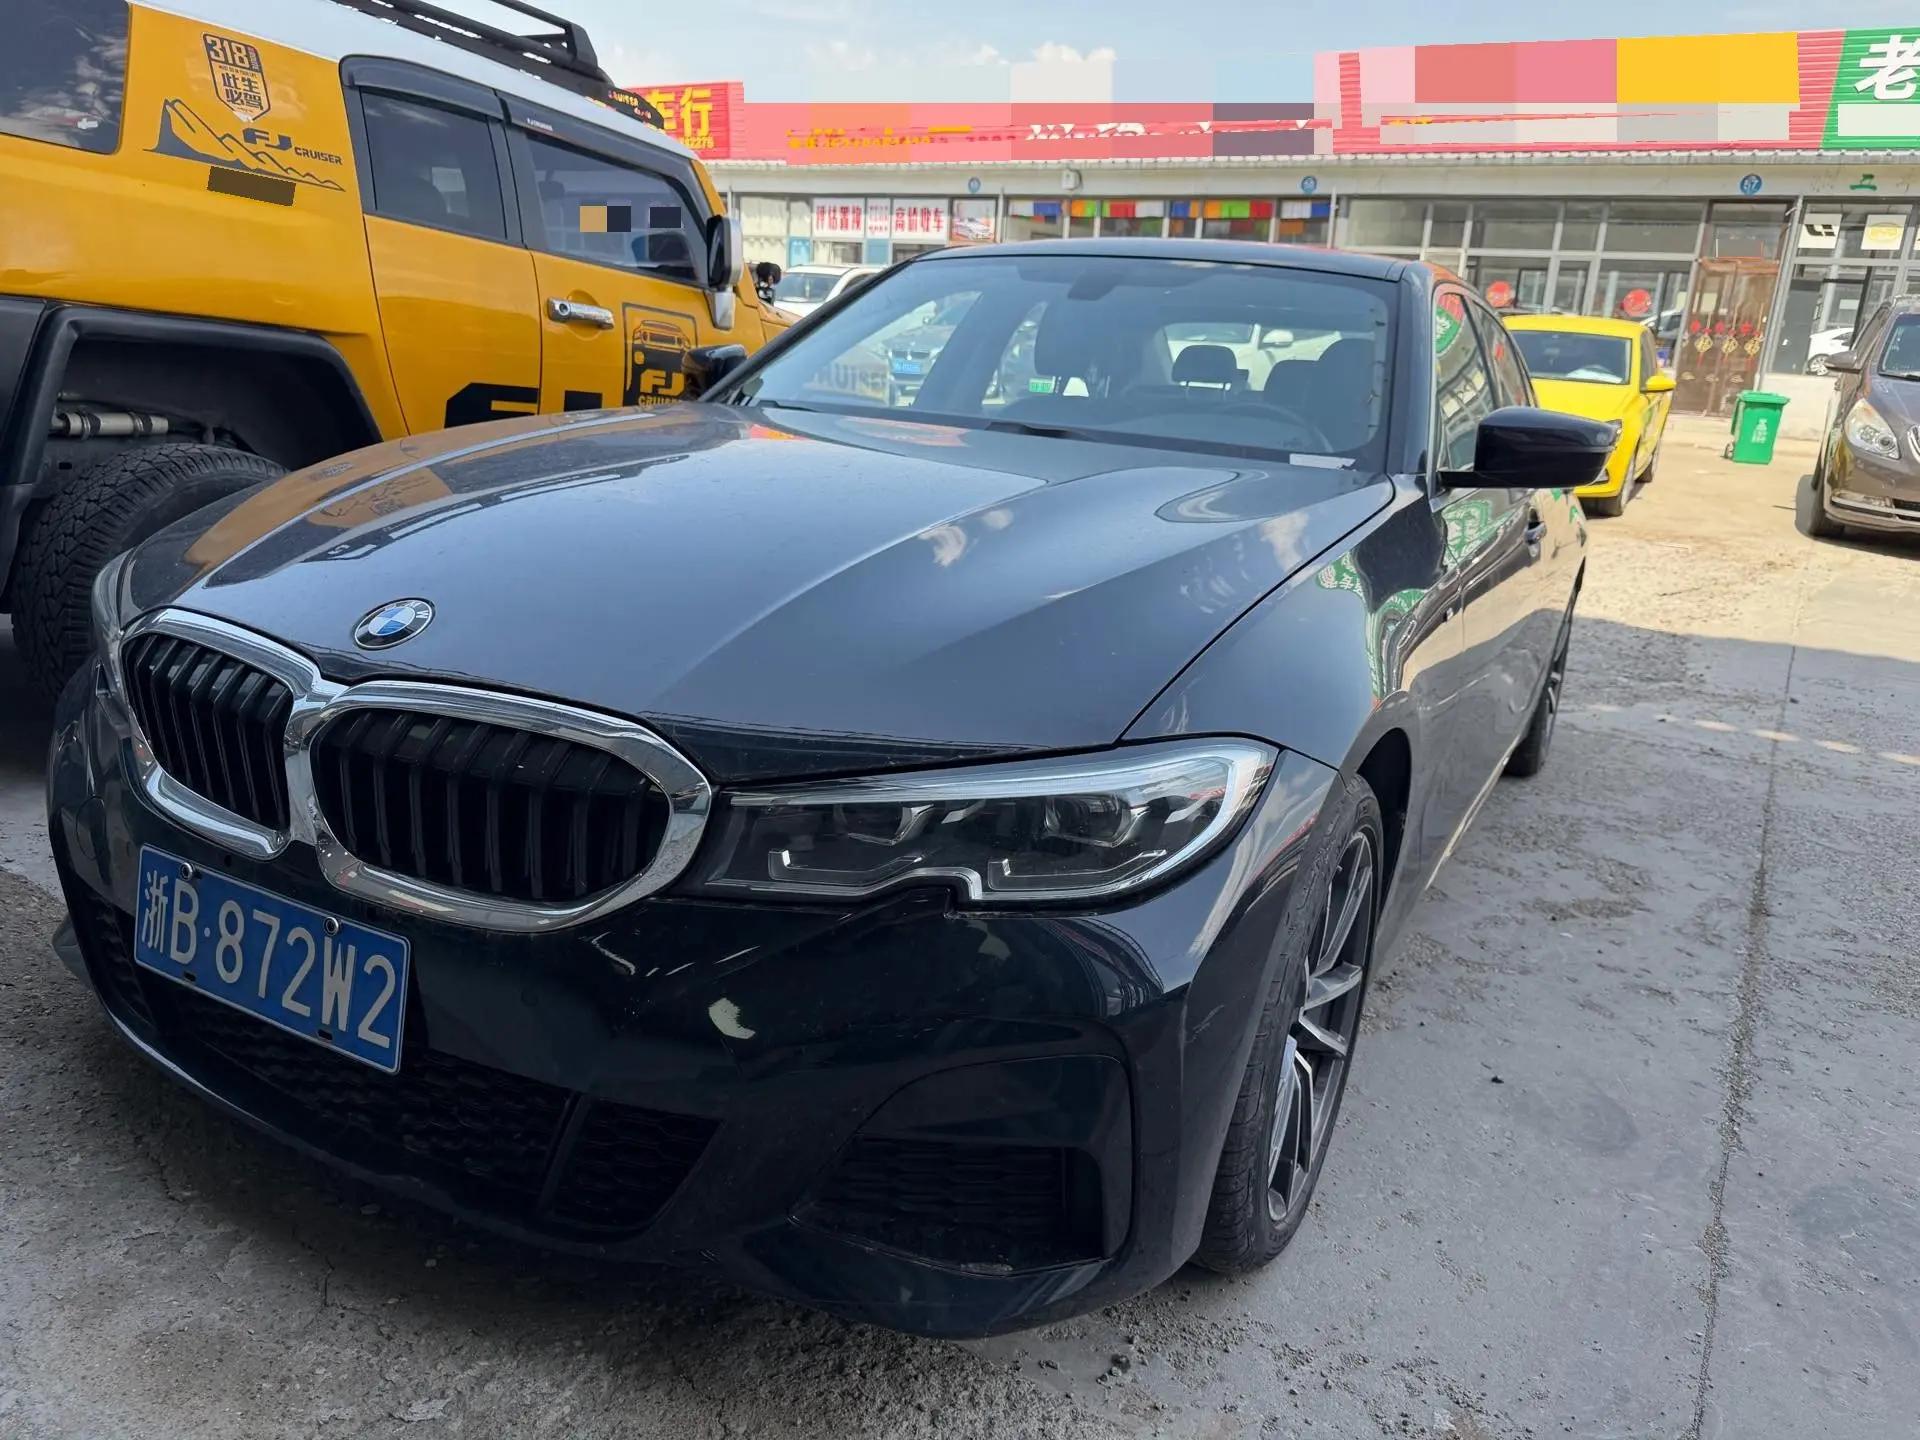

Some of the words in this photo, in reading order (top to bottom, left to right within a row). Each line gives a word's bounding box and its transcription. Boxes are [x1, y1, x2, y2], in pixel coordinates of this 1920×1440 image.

[206, 37, 250, 67] 318
[1854, 35, 1920, 100] 老
[222, 72, 261, 94] 此生
[224, 88, 264, 111] 必驾
[647, 87, 713, 137] 车行
[243, 127, 292, 151] FJ
[294, 147, 343, 165] CRUISER
[895, 206, 945, 232] 高价收车
[640, 369, 685, 396] FJ
